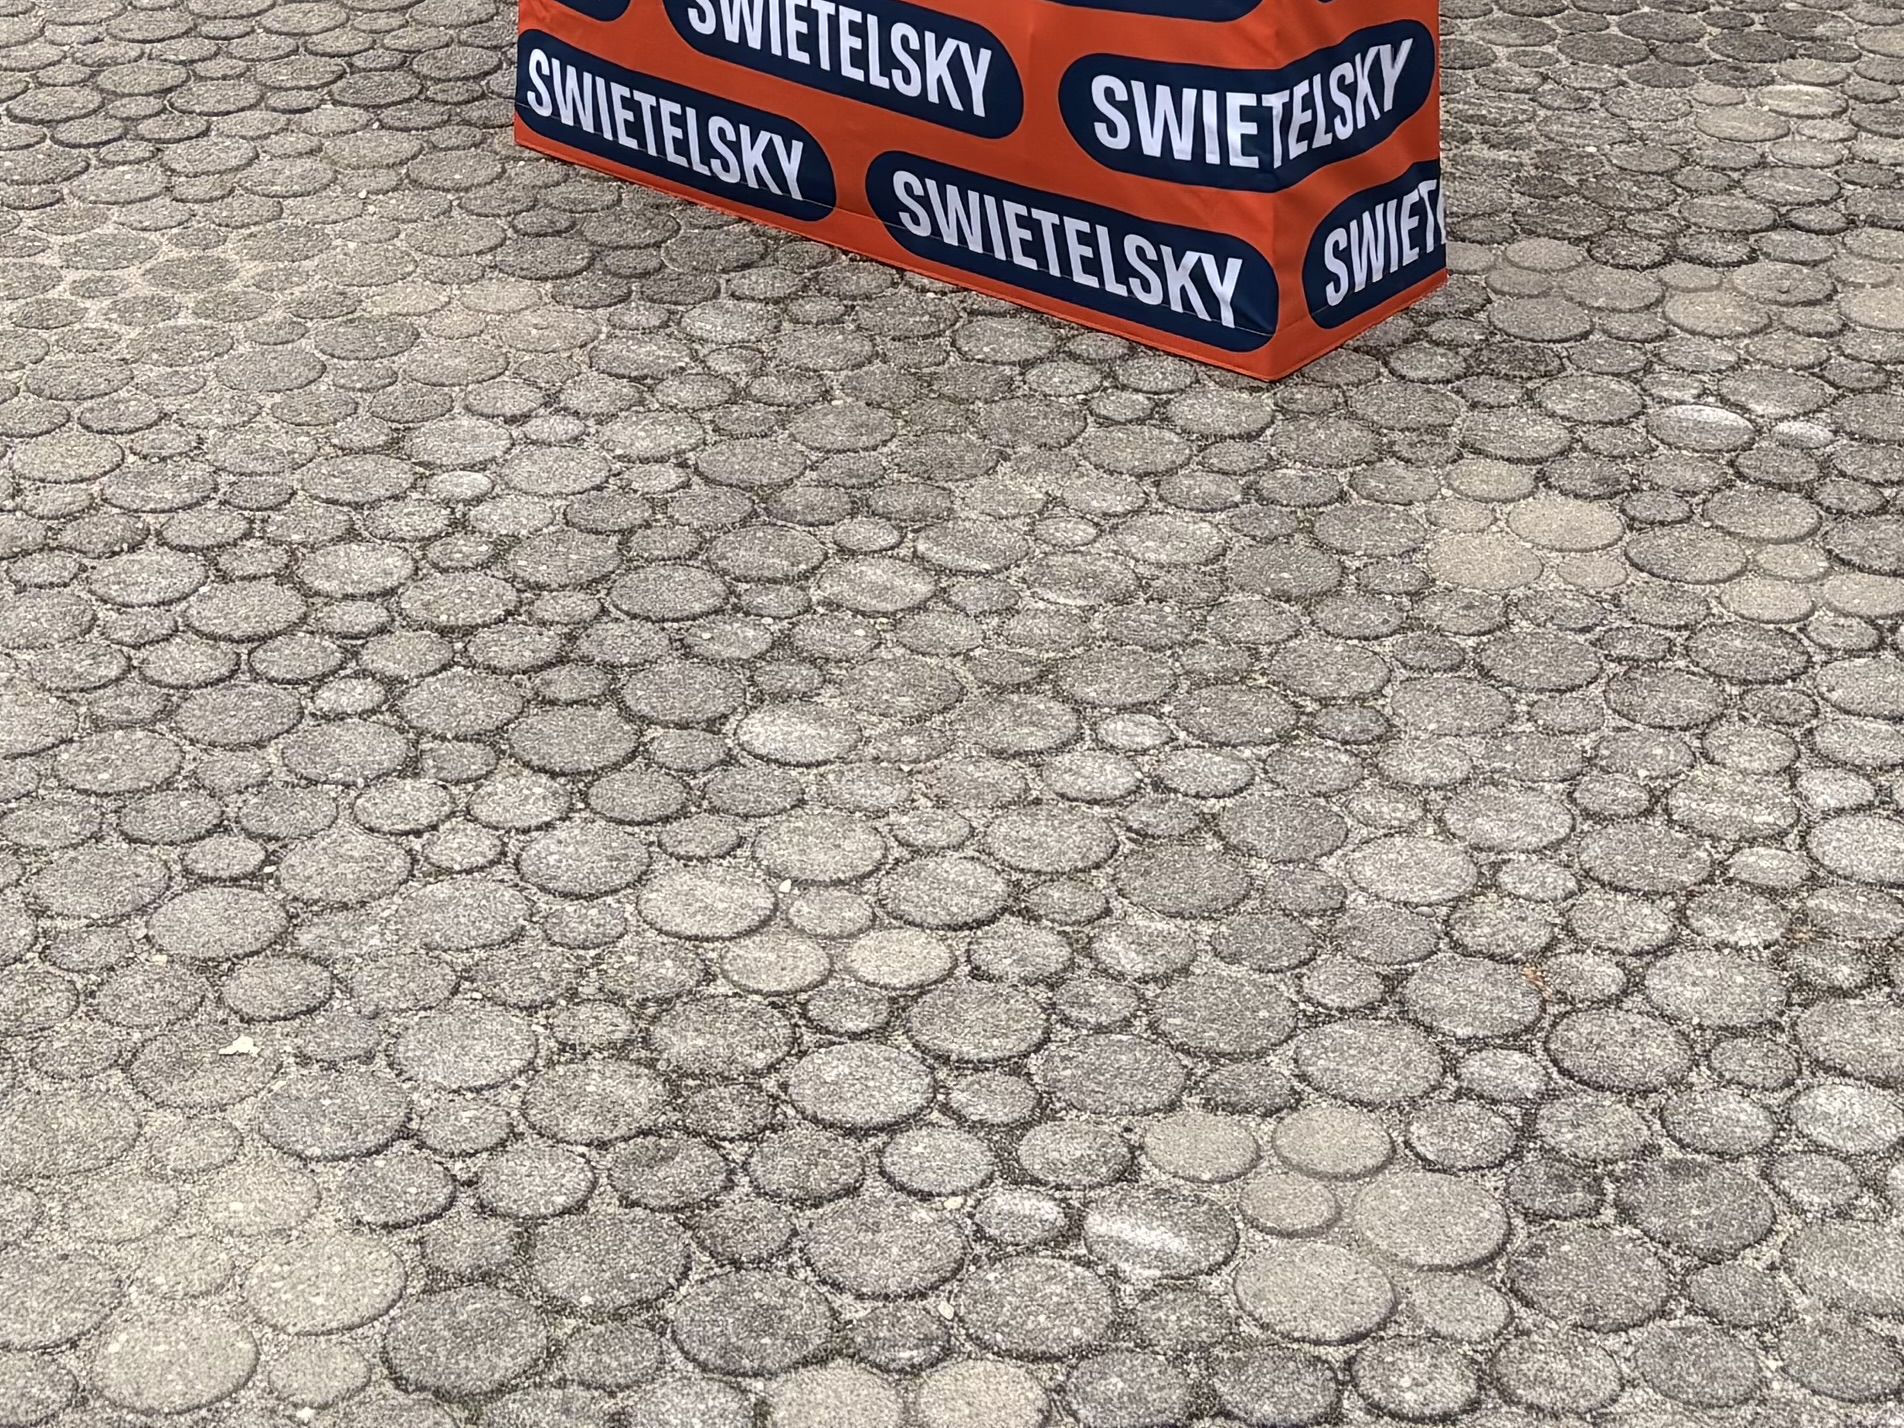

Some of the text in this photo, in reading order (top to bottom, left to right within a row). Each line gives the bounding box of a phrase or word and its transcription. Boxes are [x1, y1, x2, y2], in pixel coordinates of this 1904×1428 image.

[526, 47, 805, 201] SWIETELSKY
[1092, 39, 1412, 168] SWIETELSKY
[892, 169, 1244, 329] SWIETELSKY
